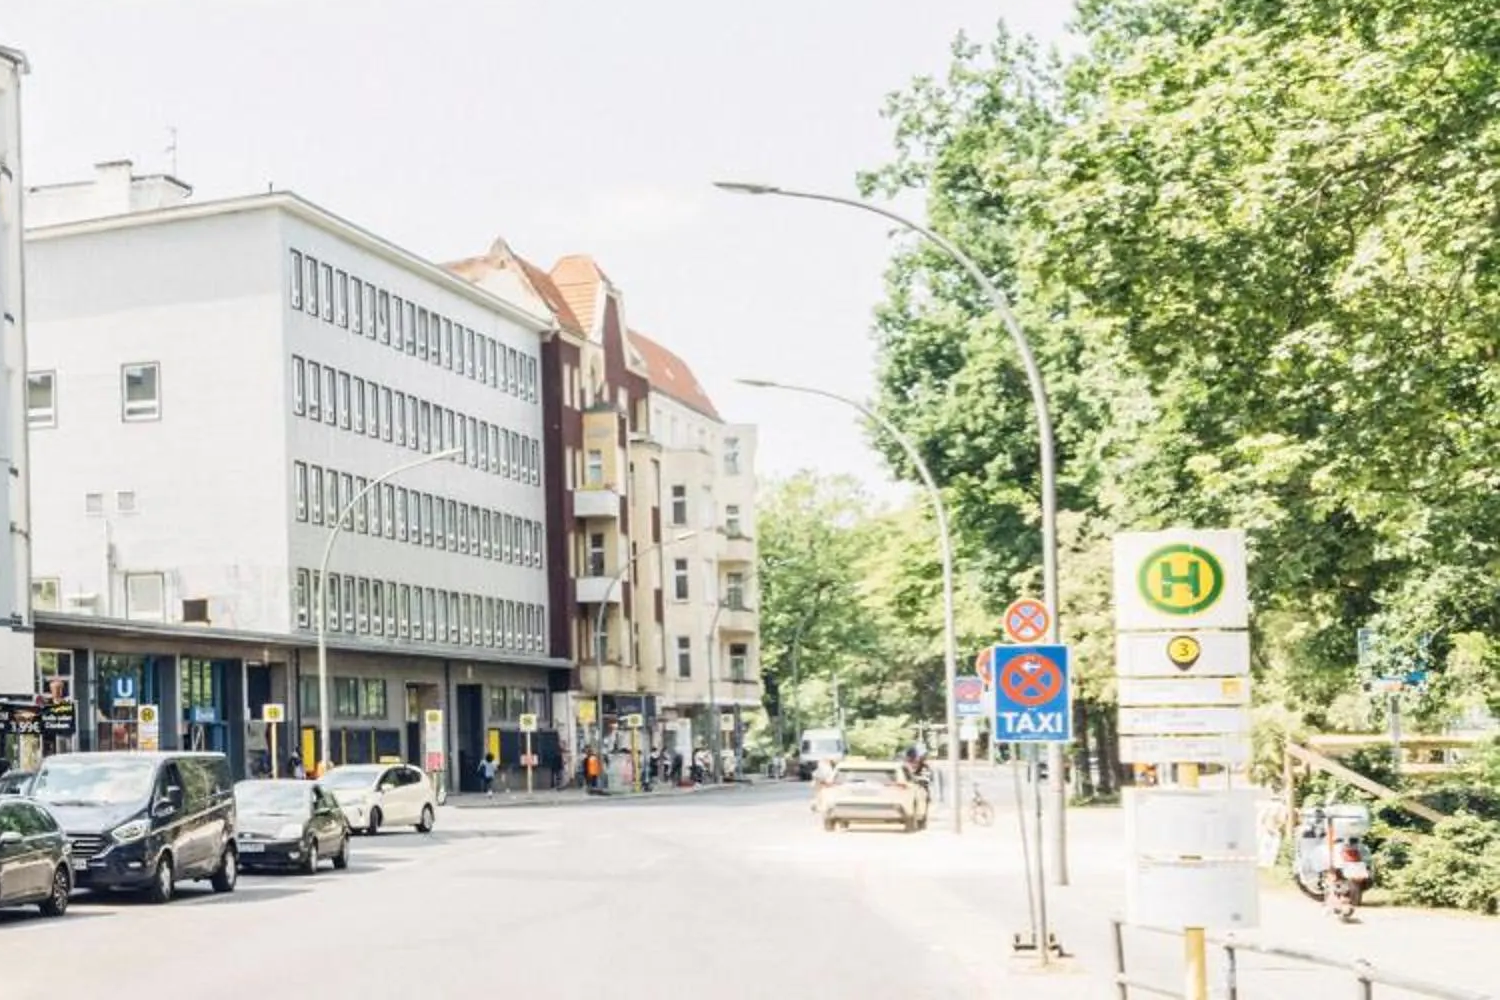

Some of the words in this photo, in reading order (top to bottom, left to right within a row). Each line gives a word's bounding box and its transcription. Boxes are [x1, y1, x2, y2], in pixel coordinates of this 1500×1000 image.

[1160, 560, 1201, 598] H
[1178, 642, 1190, 657] 3
[117, 677, 133, 697] U
[997, 711, 1063, 733] TAXI
